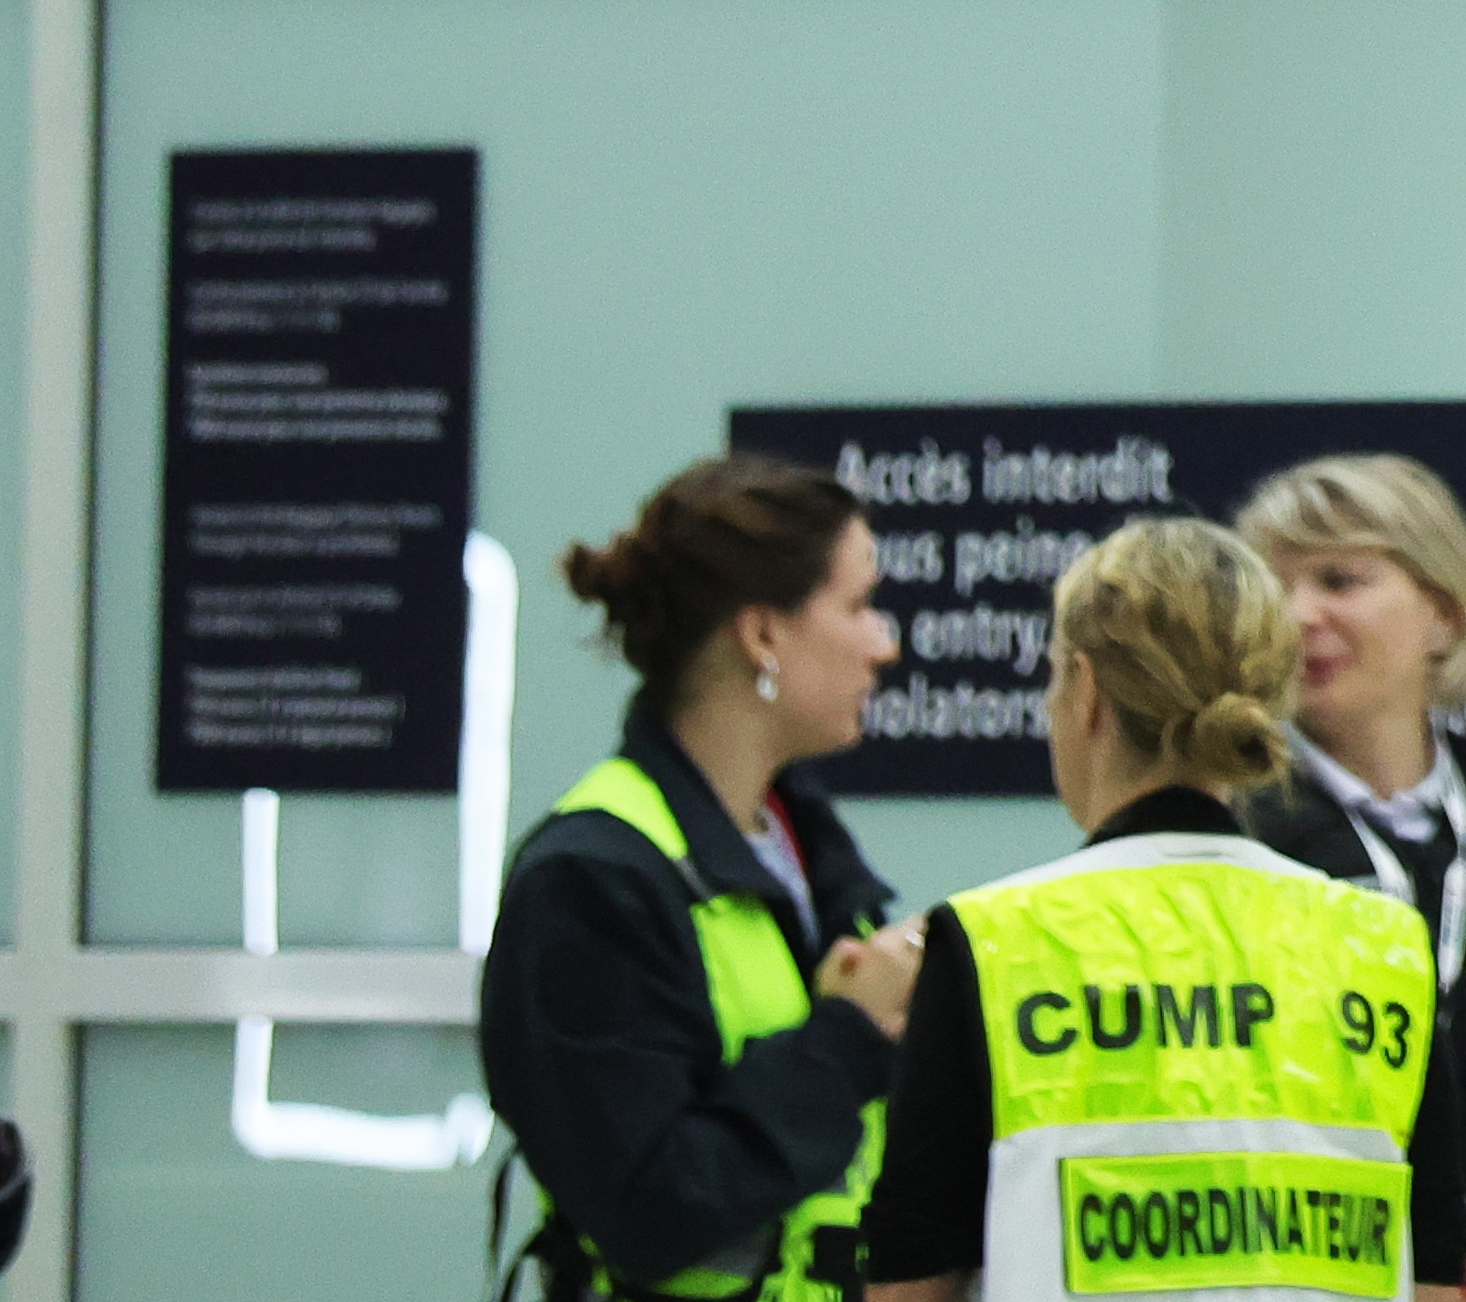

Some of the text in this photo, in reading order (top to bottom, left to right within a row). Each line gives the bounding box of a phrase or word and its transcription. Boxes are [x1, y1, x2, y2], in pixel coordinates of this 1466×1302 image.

[835, 435, 1173, 503] Accès interdit
[863, 671, 1052, 738] iolators
[1015, 981, 1411, 1069] CUMP 93
[1080, 1185, 1390, 1264] COORDINATEUR
